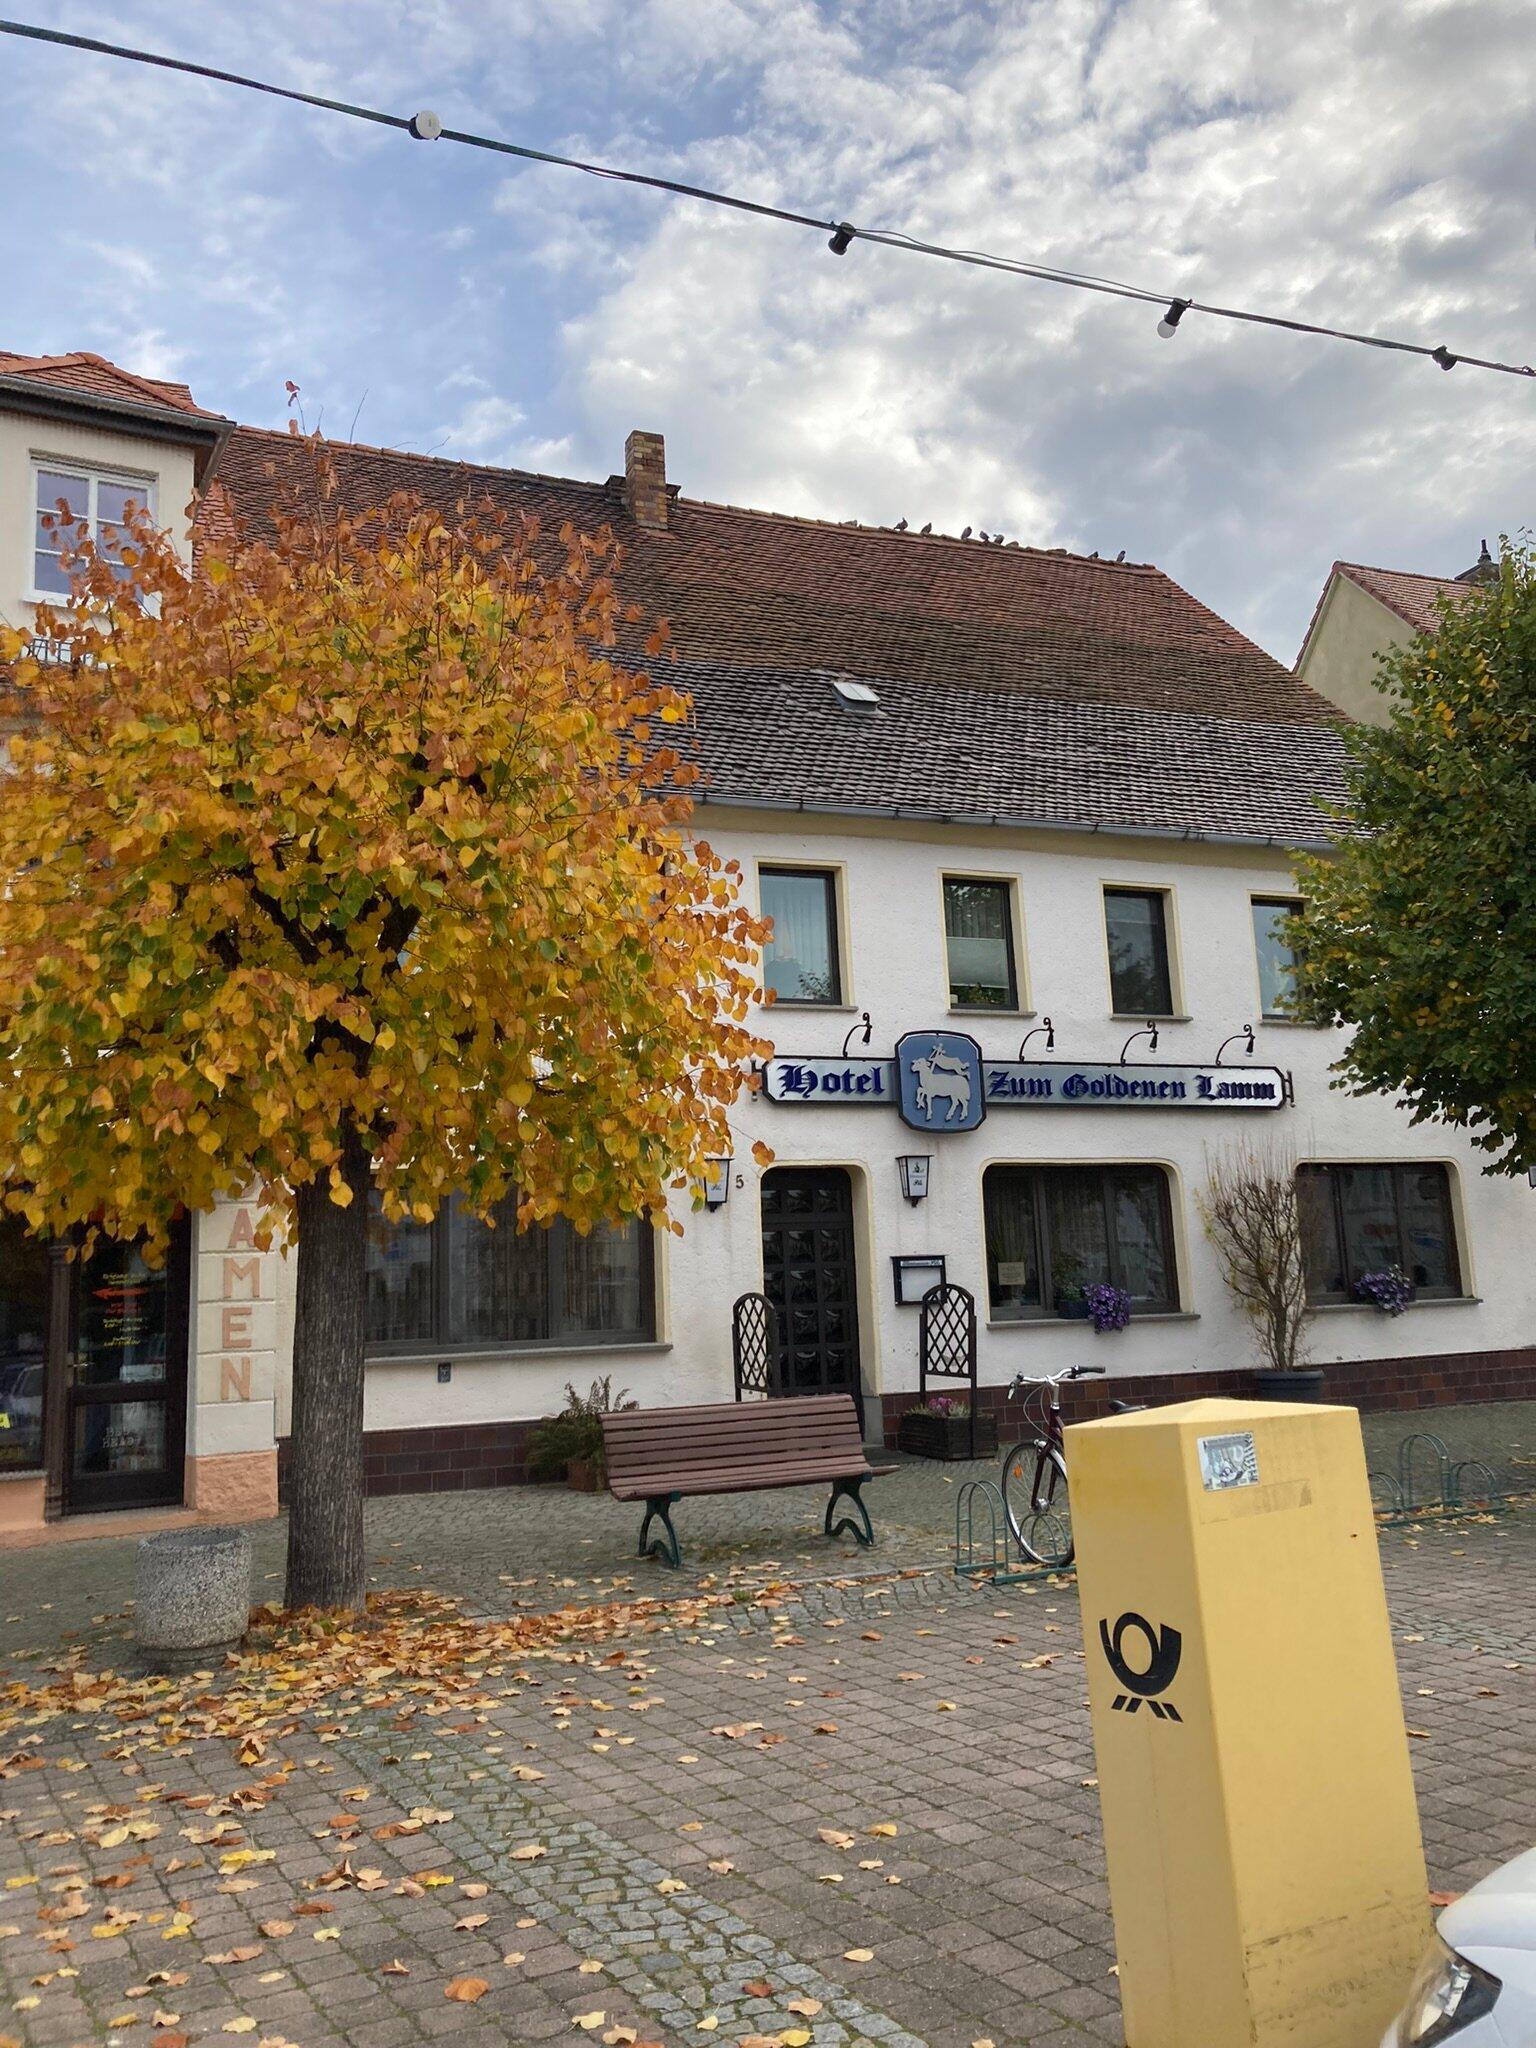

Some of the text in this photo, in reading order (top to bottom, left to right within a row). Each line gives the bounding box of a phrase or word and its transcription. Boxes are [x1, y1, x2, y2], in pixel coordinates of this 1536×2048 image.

[777, 1064, 1277, 1100] Hotel Zum Goldenen Lamm
[735, 1174, 745, 1189] 5
